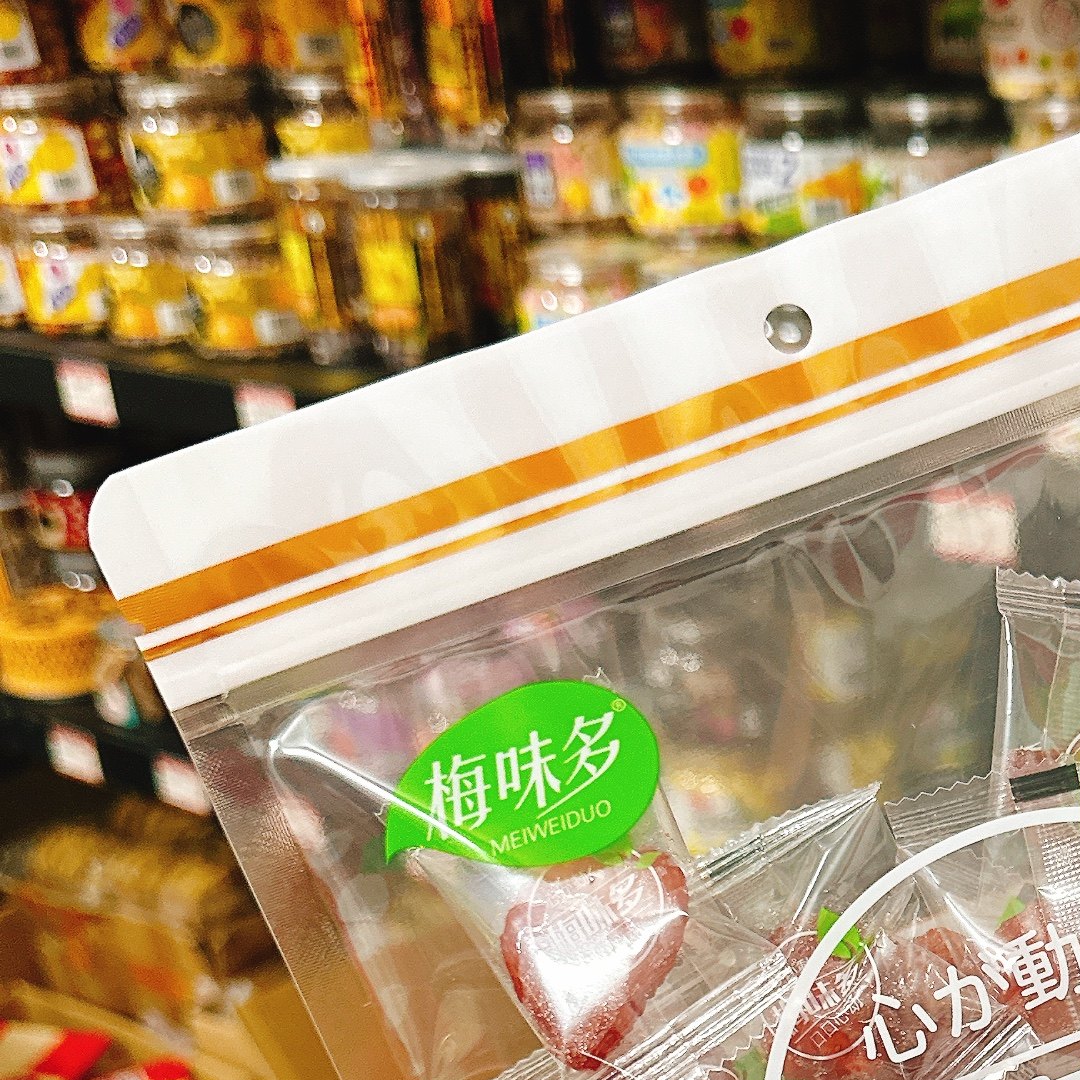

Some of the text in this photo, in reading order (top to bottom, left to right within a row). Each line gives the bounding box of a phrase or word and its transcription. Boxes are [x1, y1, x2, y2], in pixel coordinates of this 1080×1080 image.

[424, 711, 621, 842] 梅味多
[489, 799, 612, 856] MEIWEIDUO
